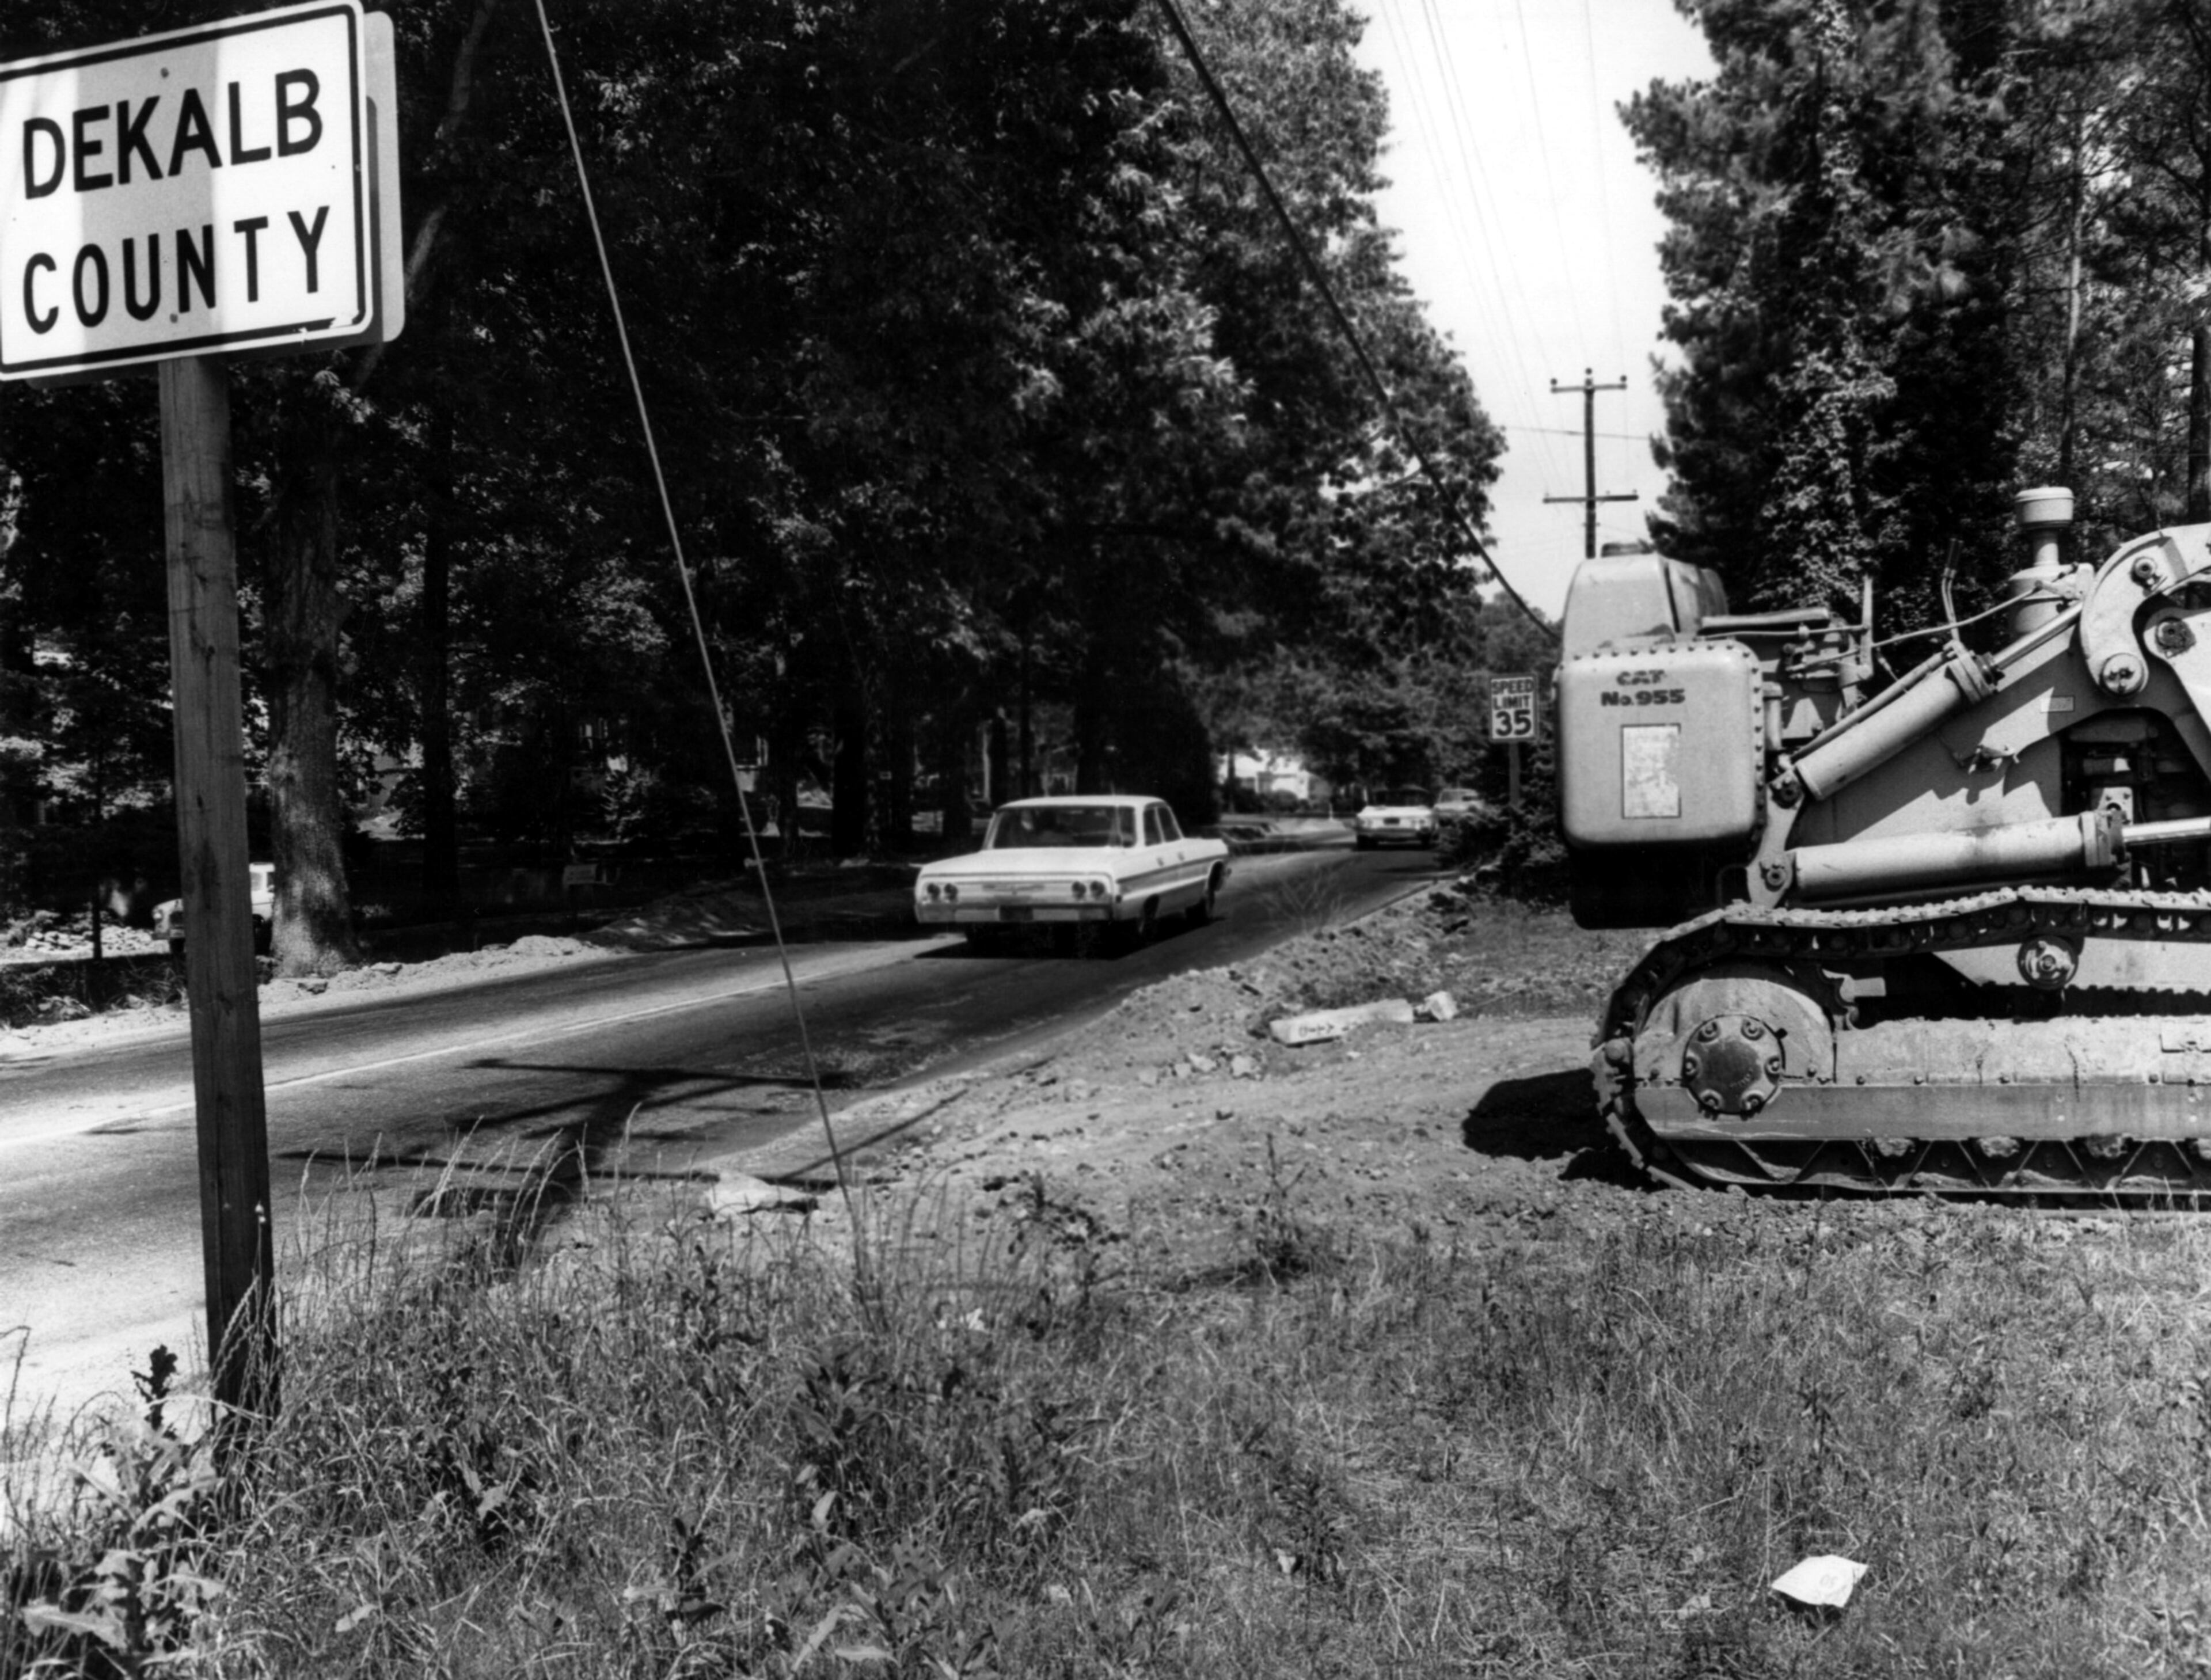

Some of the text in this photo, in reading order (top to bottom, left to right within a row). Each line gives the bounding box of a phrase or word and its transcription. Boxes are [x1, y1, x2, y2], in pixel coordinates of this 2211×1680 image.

[24, 68, 322, 199] DEKALB
[24, 206, 329, 335] COUNTY
[1492, 680, 1534, 694] SPEED
[1494, 695, 1530, 710] LIMIT
[1496, 709, 1532, 736] 35
